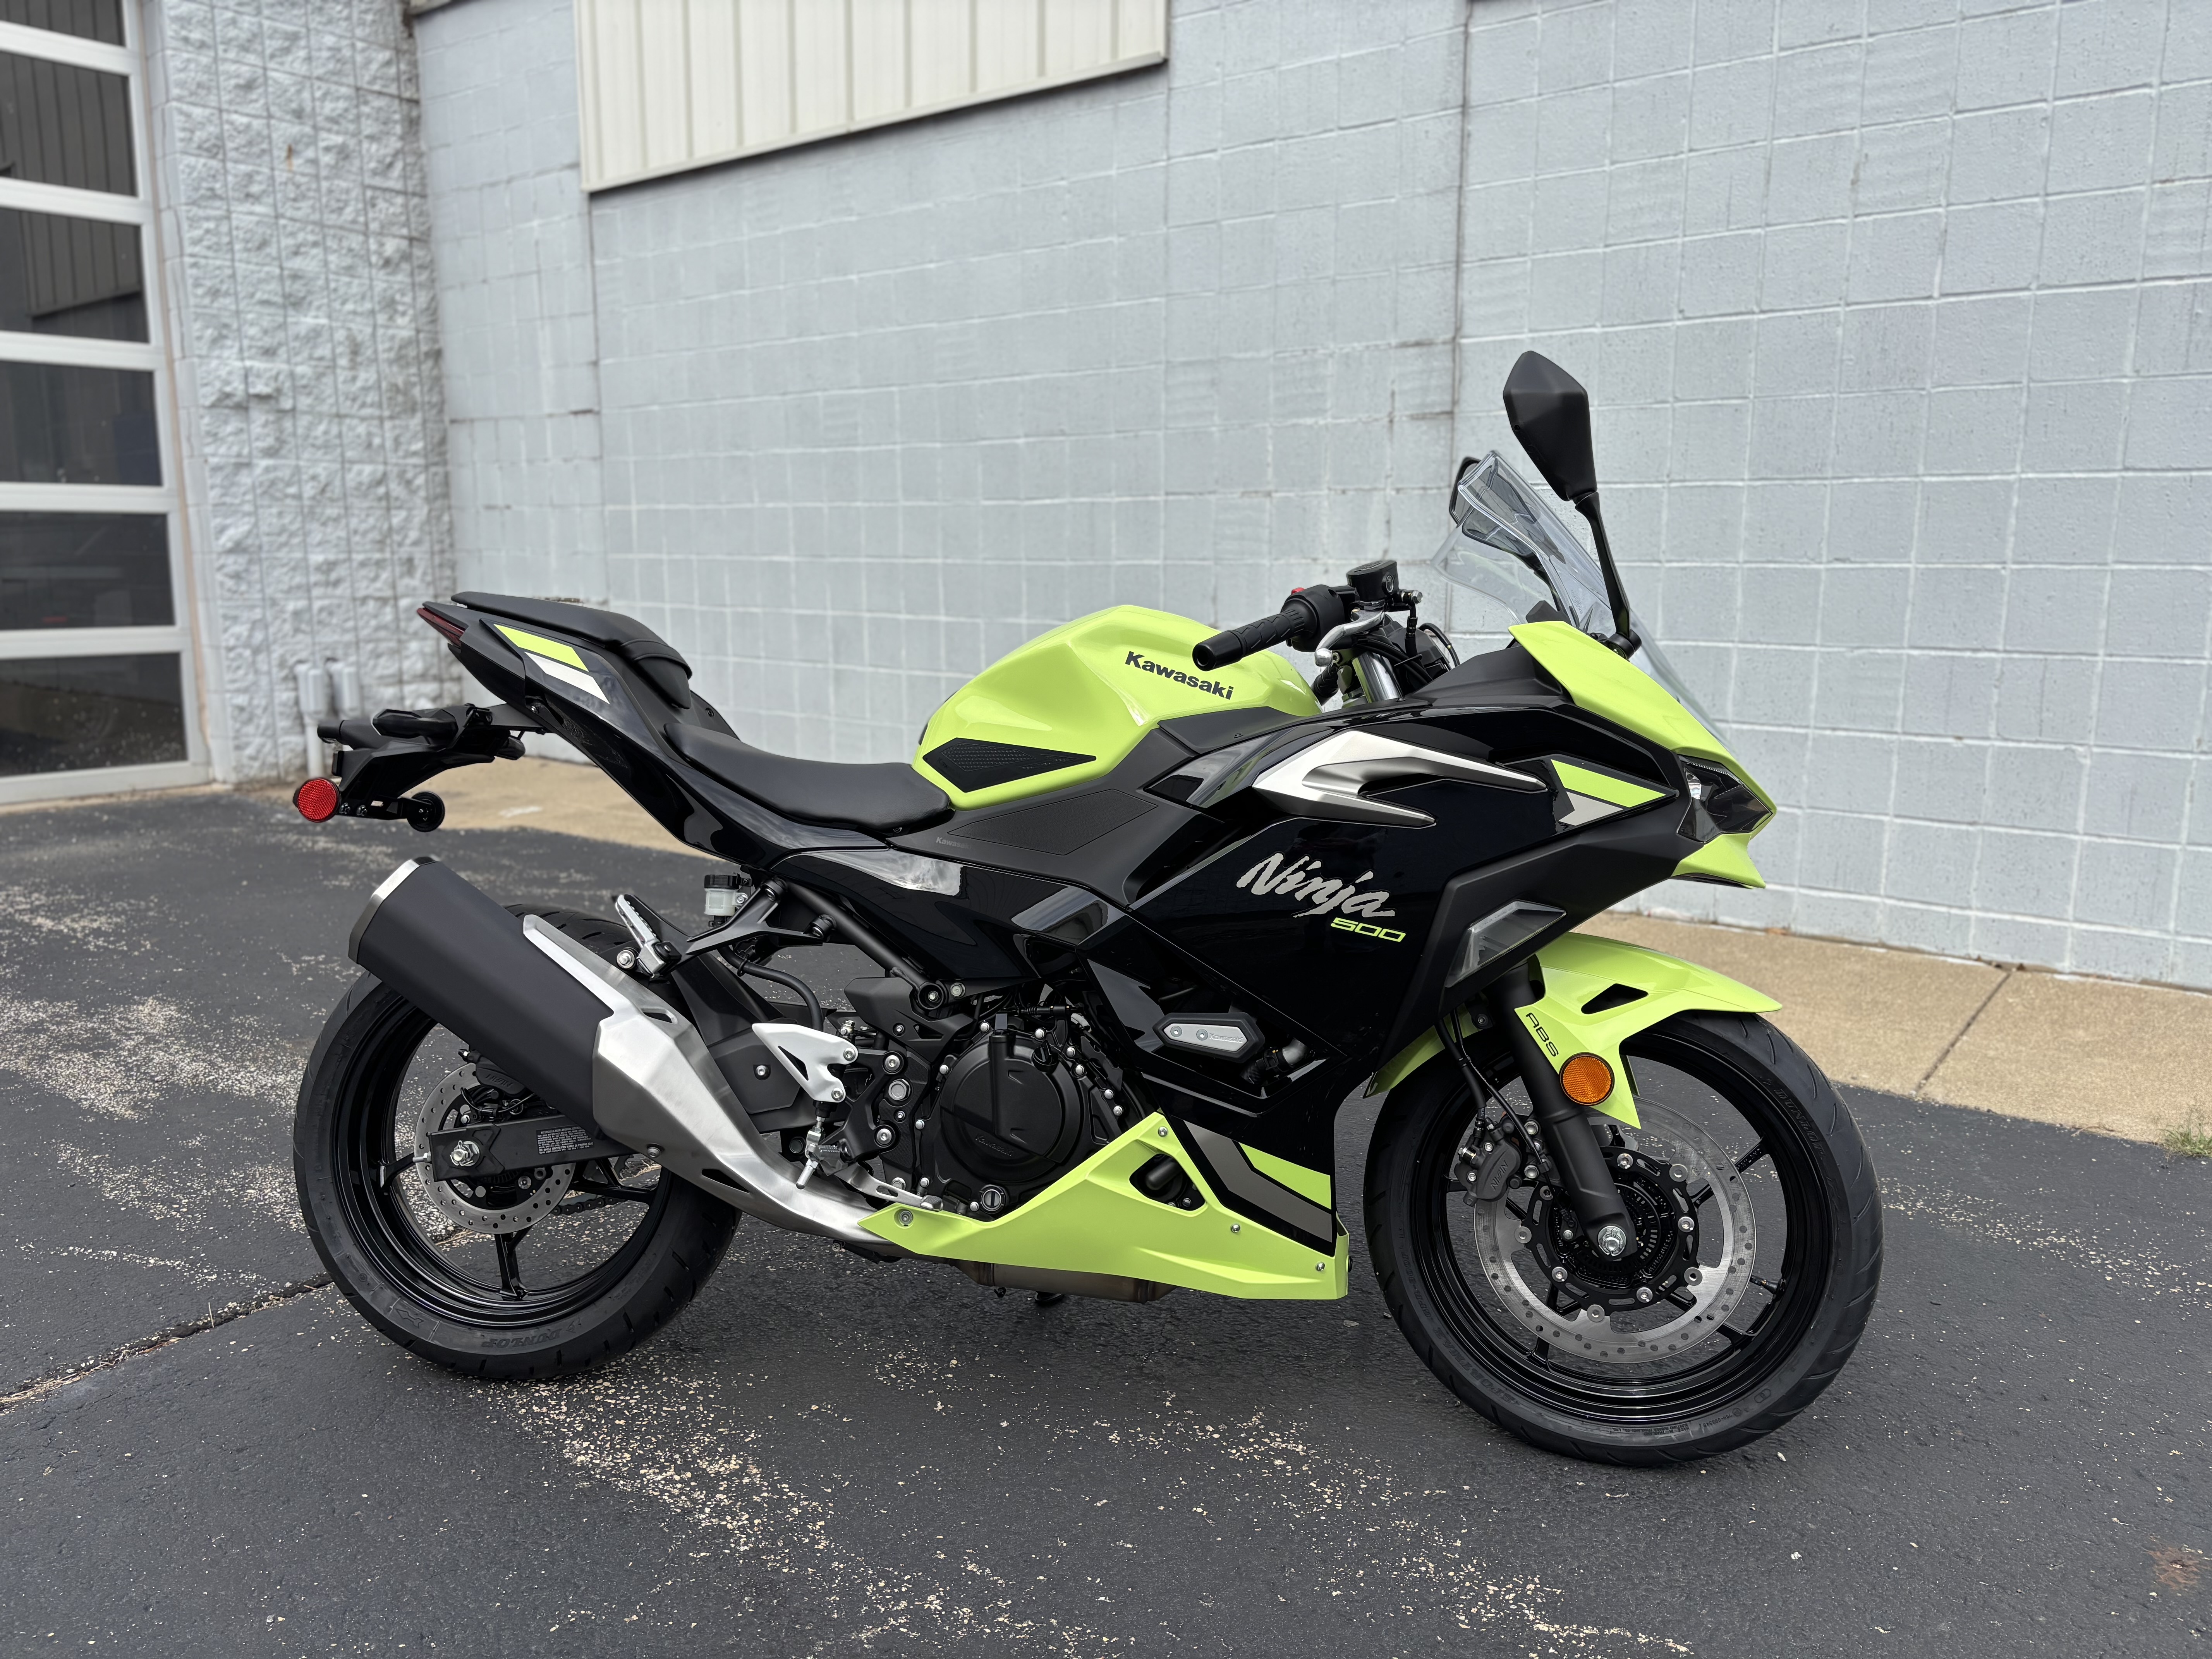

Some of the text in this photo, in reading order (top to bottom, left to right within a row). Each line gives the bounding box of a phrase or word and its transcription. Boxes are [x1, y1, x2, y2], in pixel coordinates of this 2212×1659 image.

[1125, 651, 1234, 700] Kawasaki
[1237, 853, 1395, 918] Ninja
[1331, 917, 1406, 942] 500
[1209, 1033, 1244, 1044] Kawasaki
[1525, 1012, 1559, 1057] ABS
[1774, 1089, 1825, 1156] DUNLOP
[481, 1329, 562, 1348] DUNLOP
